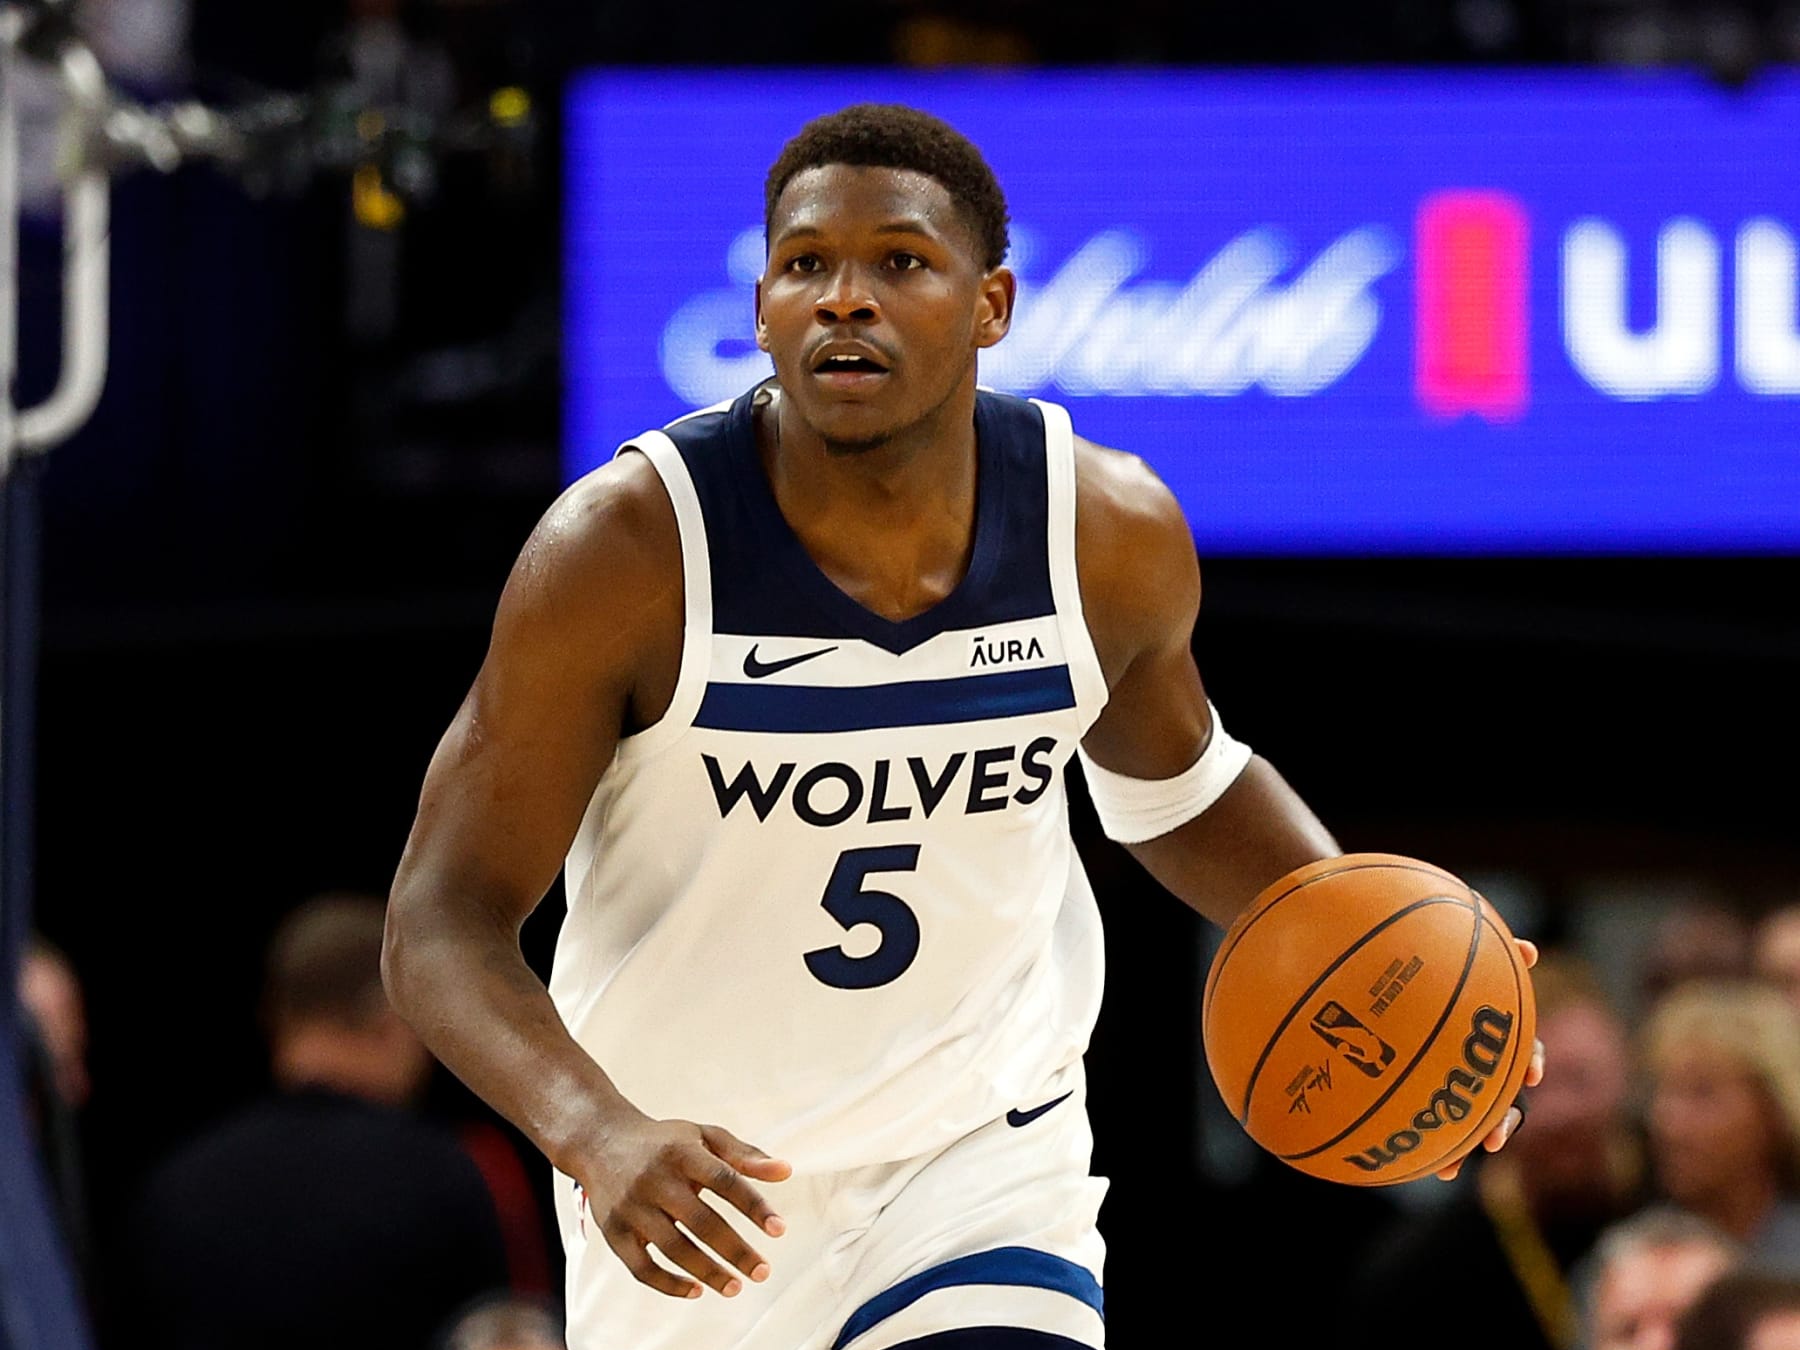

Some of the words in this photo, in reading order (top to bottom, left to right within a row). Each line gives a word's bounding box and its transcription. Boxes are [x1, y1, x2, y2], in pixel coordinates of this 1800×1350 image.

[970, 637, 1045, 667] ĀURA
[701, 736, 1058, 827] WOLVES
[803, 844, 922, 990] 5
[1342, 1005, 1513, 1172] Wilson
